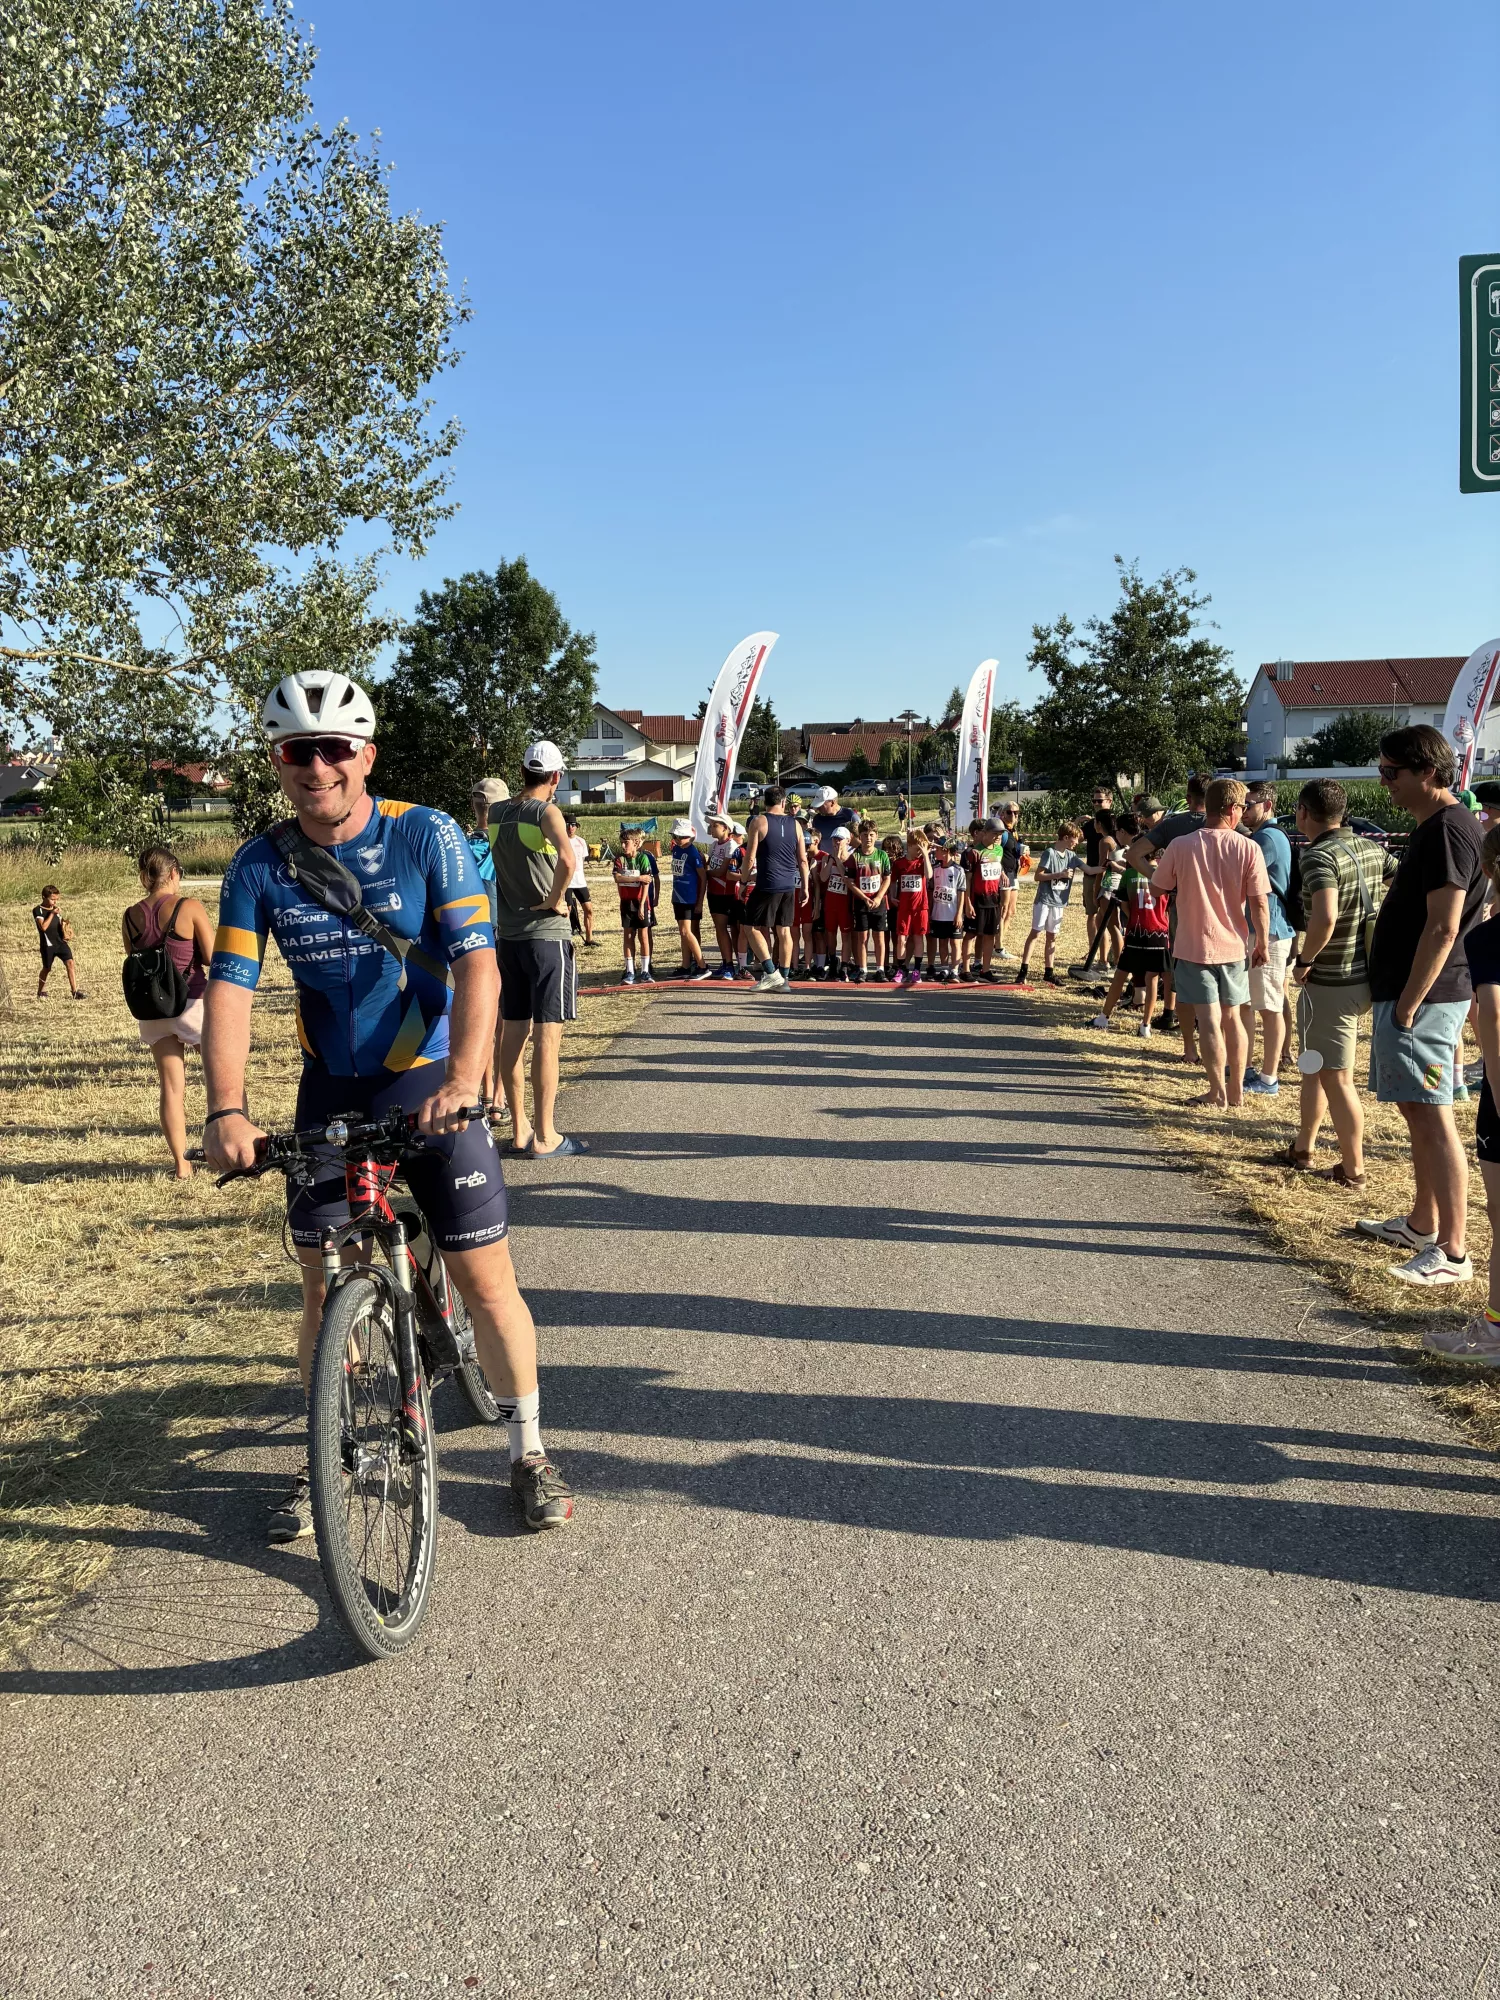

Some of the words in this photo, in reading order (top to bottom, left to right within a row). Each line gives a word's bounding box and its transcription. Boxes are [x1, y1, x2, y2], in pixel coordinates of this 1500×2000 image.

[428, 814, 454, 850] SPORT
[901, 880, 920, 889] 3438
[933, 890, 953, 902] 3435
[445, 1221, 505, 1242] MAISCH
